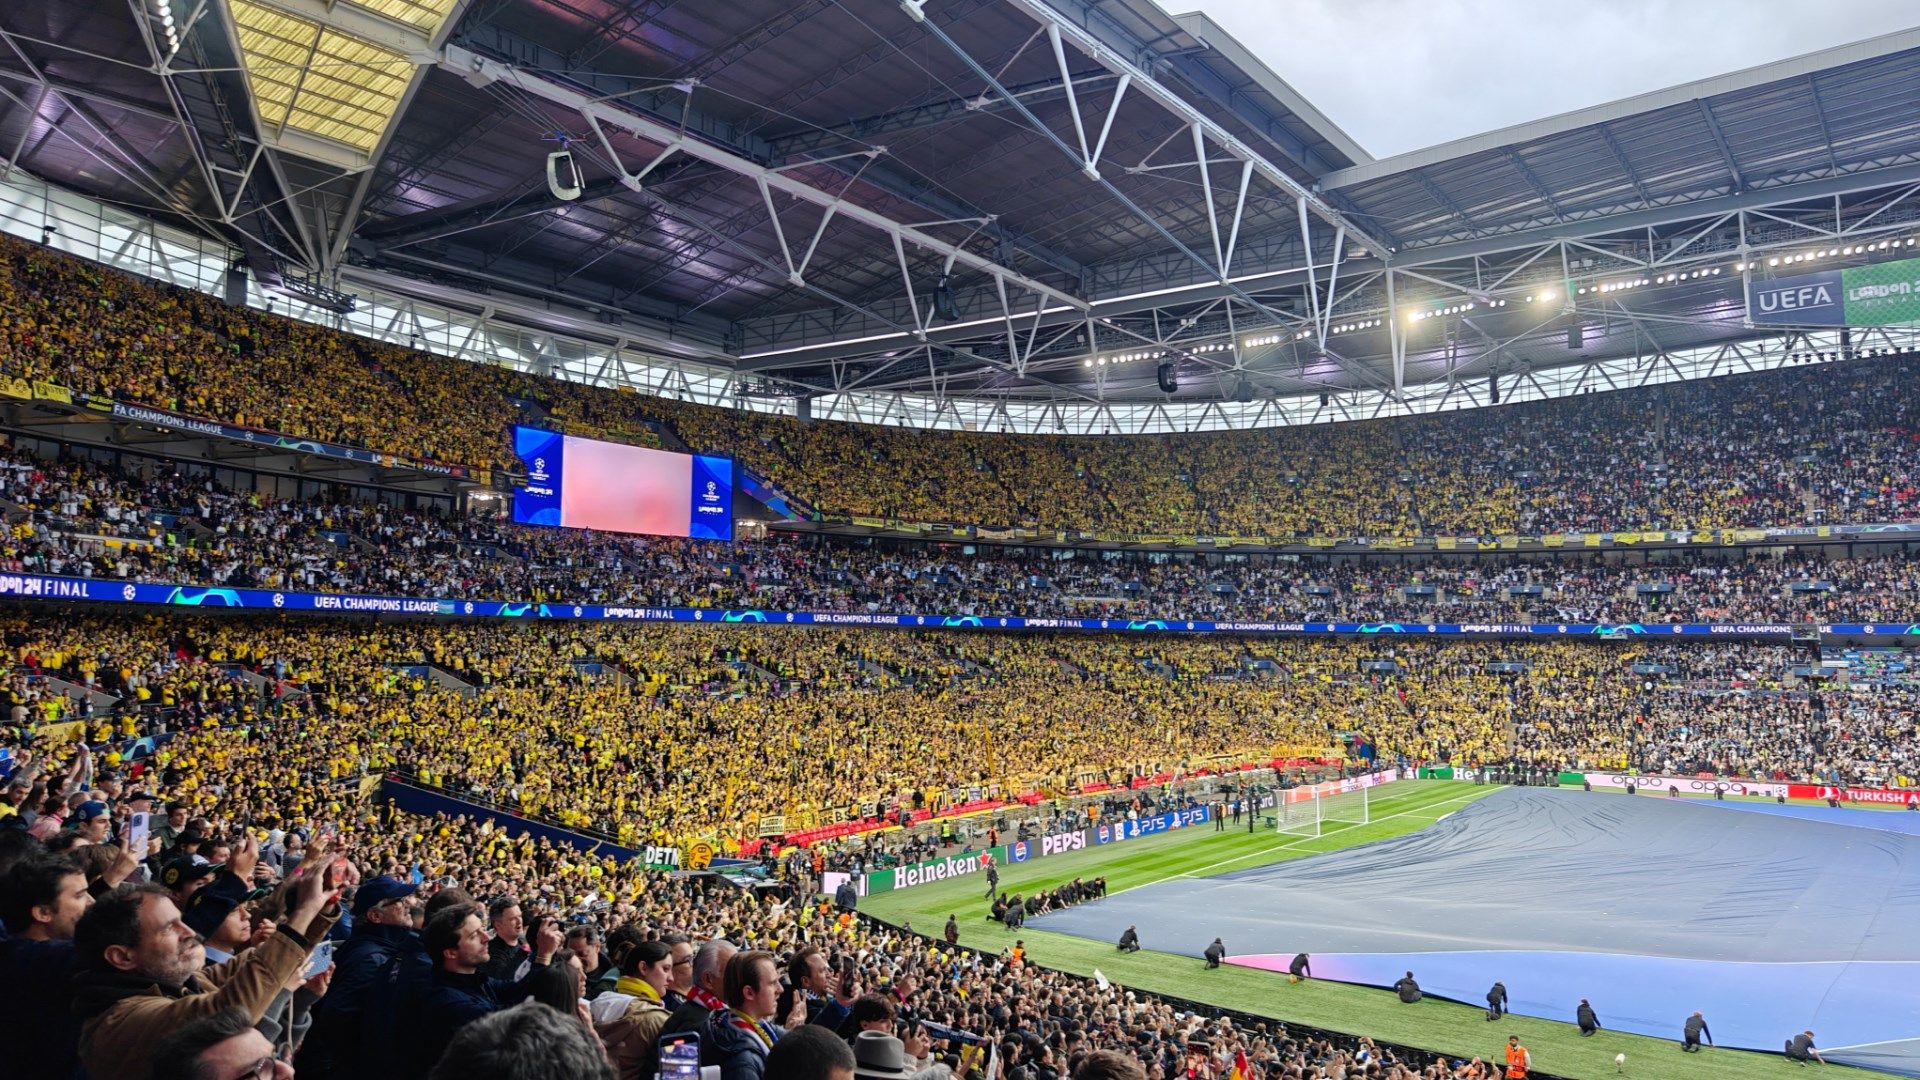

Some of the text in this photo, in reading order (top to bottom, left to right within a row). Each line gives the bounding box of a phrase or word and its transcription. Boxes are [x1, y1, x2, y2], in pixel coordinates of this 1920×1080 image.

[1759, 285, 1833, 311] UEFA
[128, 406, 186, 427] CHAMPIONS
[188, 418, 223, 434] LEAGUE
[24, 578, 42, 595] 24
[44, 580, 90, 597] FINAL
[314, 596, 439, 612] UEFA CHAMPIONS LEAGUE
[634, 608, 645, 619] 24
[646, 609, 674, 619] FINAL
[813, 614, 899, 624] UEFA CHAMPIONS LEAGUE
[1060, 619, 1083, 628] FINAL
[1215, 622, 1305, 631] UEFA CHAMPIONS LEAGUE
[1491, 625, 1502, 633] 24
[1503, 625, 1533, 633] FINAL
[1711, 625, 1791, 633] UEFA CHAMPIONS
[1611, 776, 1662, 788] oppo
[1691, 780, 1743, 792] oppo
[1846, 790, 1905, 803] TURKISH
[1182, 809, 1205, 824] PS5
[1141, 817, 1166, 833] PS5
[1042, 829, 1087, 857] PEPSI
[893, 856, 977, 890] Heineken
